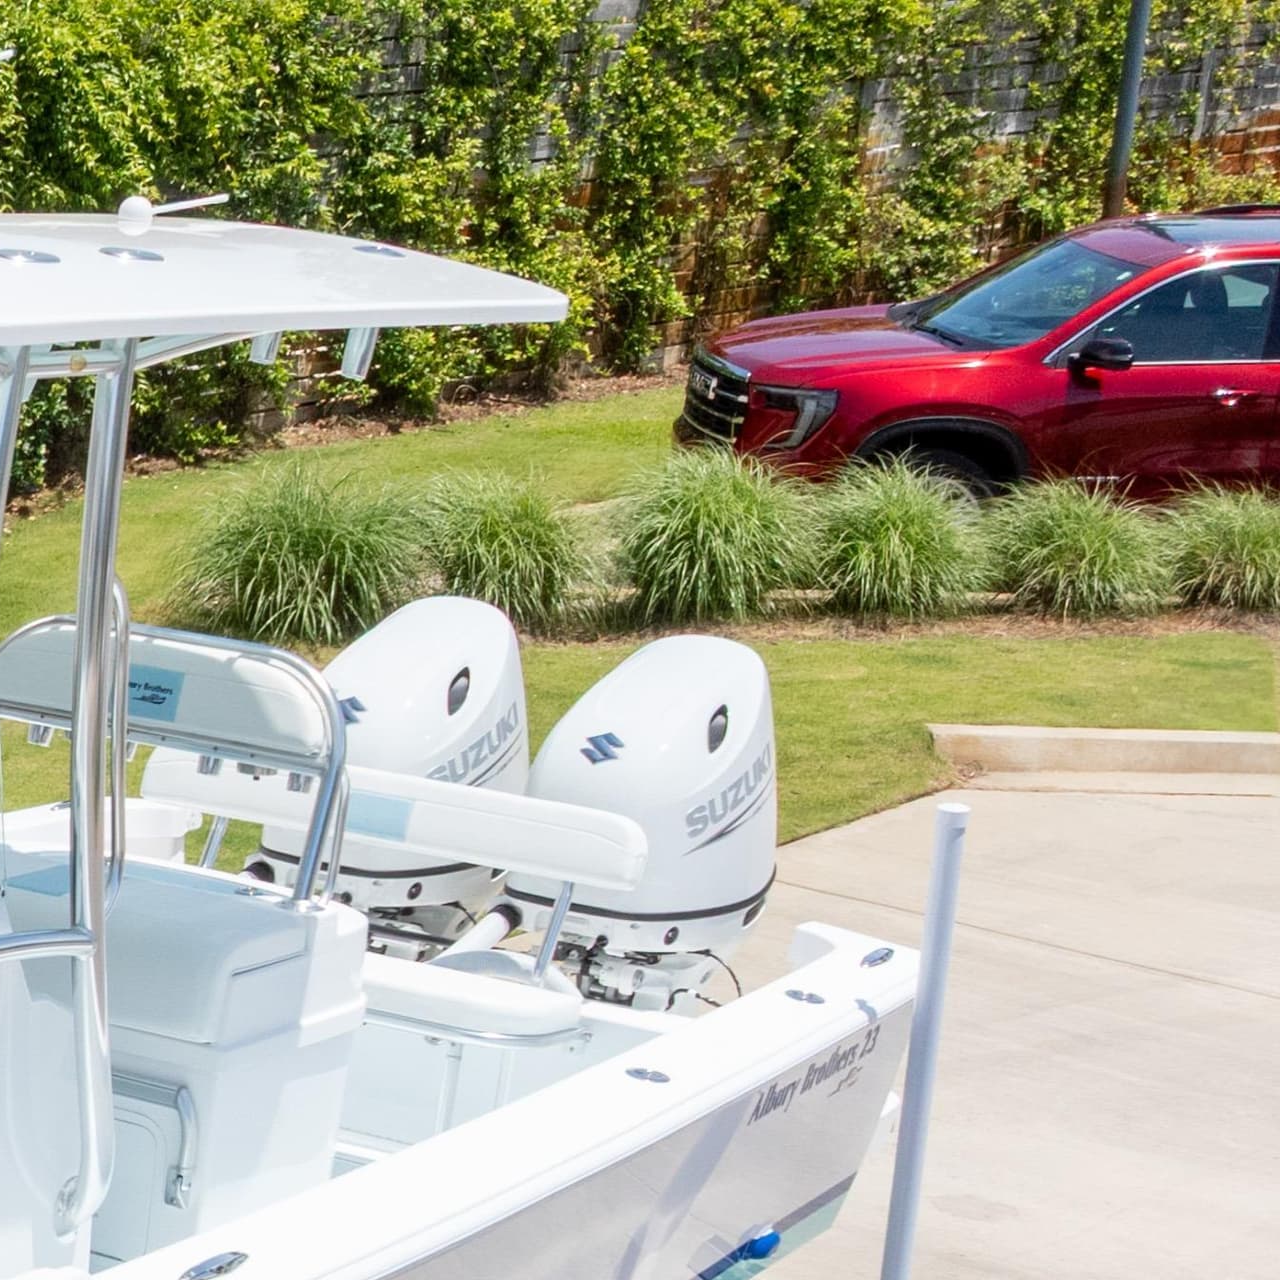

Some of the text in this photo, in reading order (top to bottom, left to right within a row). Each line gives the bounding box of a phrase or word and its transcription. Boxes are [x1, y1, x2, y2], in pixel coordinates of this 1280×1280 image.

[685, 741, 772, 839] SUZUKI
[747, 1025, 881, 1126] Albury Brothers 23
